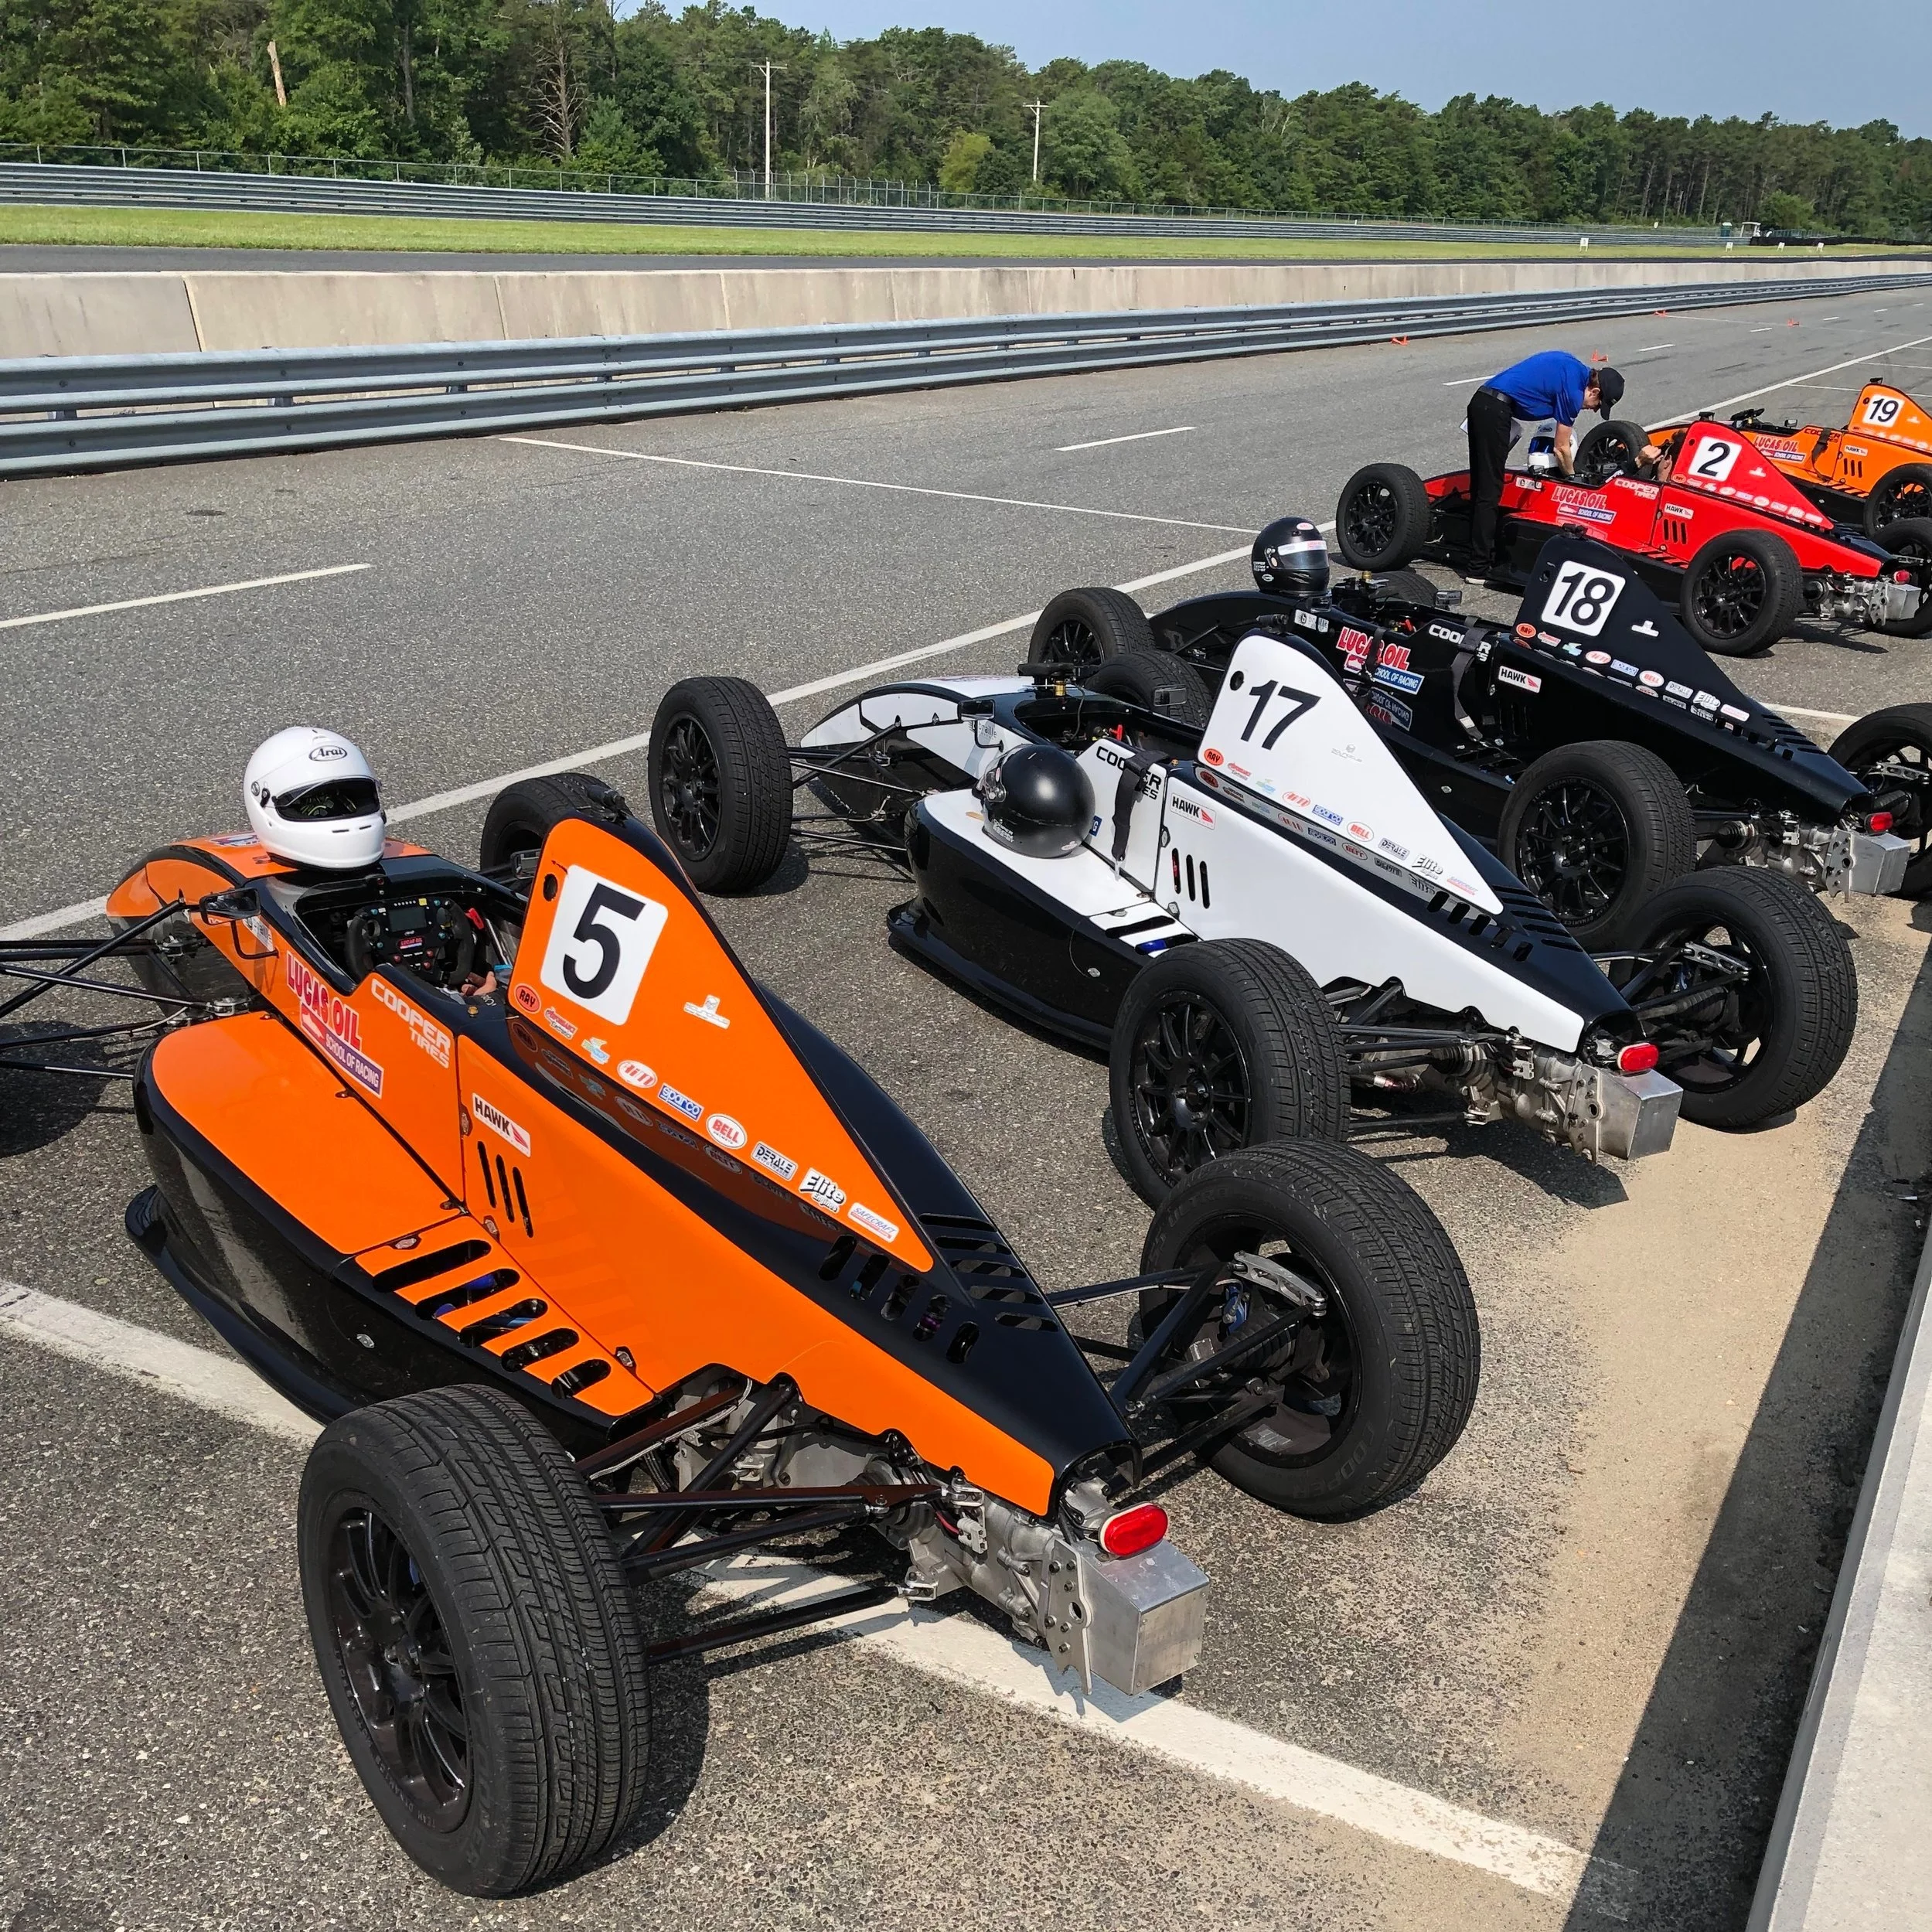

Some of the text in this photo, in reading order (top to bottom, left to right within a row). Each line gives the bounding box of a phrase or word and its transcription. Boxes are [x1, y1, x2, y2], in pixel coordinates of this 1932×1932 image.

[1869, 398, 1899, 422] 19
[1754, 436, 1798, 452] LUCAS OIL
[1697, 442, 1730, 477] 2
[1552, 486, 1607, 510] LUCAS OIL
[1614, 478, 1660, 494] COOPER
[1634, 490, 1657, 500] TIRES
[1578, 508, 1592, 518] SCHOOL
[1597, 512, 1613, 520] RACING
[1666, 505, 1684, 514] HAWK
[1554, 571, 1615, 626] 18
[1429, 624, 1492, 654] COOR
[1383, 643, 1411, 671] OIL
[1391, 673, 1399, 683] OF
[1399, 674, 1419, 689] RACING
[1501, 668, 1526, 684] HAWK
[1241, 680, 1321, 750] 17
[313, 747, 343, 760] Arai
[1207, 751, 1221, 763] RAY
[1172, 796, 1200, 818] HAWK
[1350, 824, 1370, 840] BELL
[1381, 840, 1408, 857] DERALE
[1416, 856, 1443, 875] Elite
[563, 883, 646, 1000] 5
[287, 951, 363, 1051] LUCAS OIL
[520, 989, 537, 1007] RAY
[371, 978, 451, 1055] COOPER
[409, 1027, 449, 1069] TIRES
[325, 1032, 380, 1089] SCHOOL OF RACING
[661, 1085, 700, 1115] sparco
[474, 1096, 511, 1137] HAWK
[712, 1119, 739, 1144] BELL
[757, 1146, 793, 1174] DERALE
[806, 1174, 845, 1204] Elite
[854, 1207, 897, 1233] SAFECRAFT
